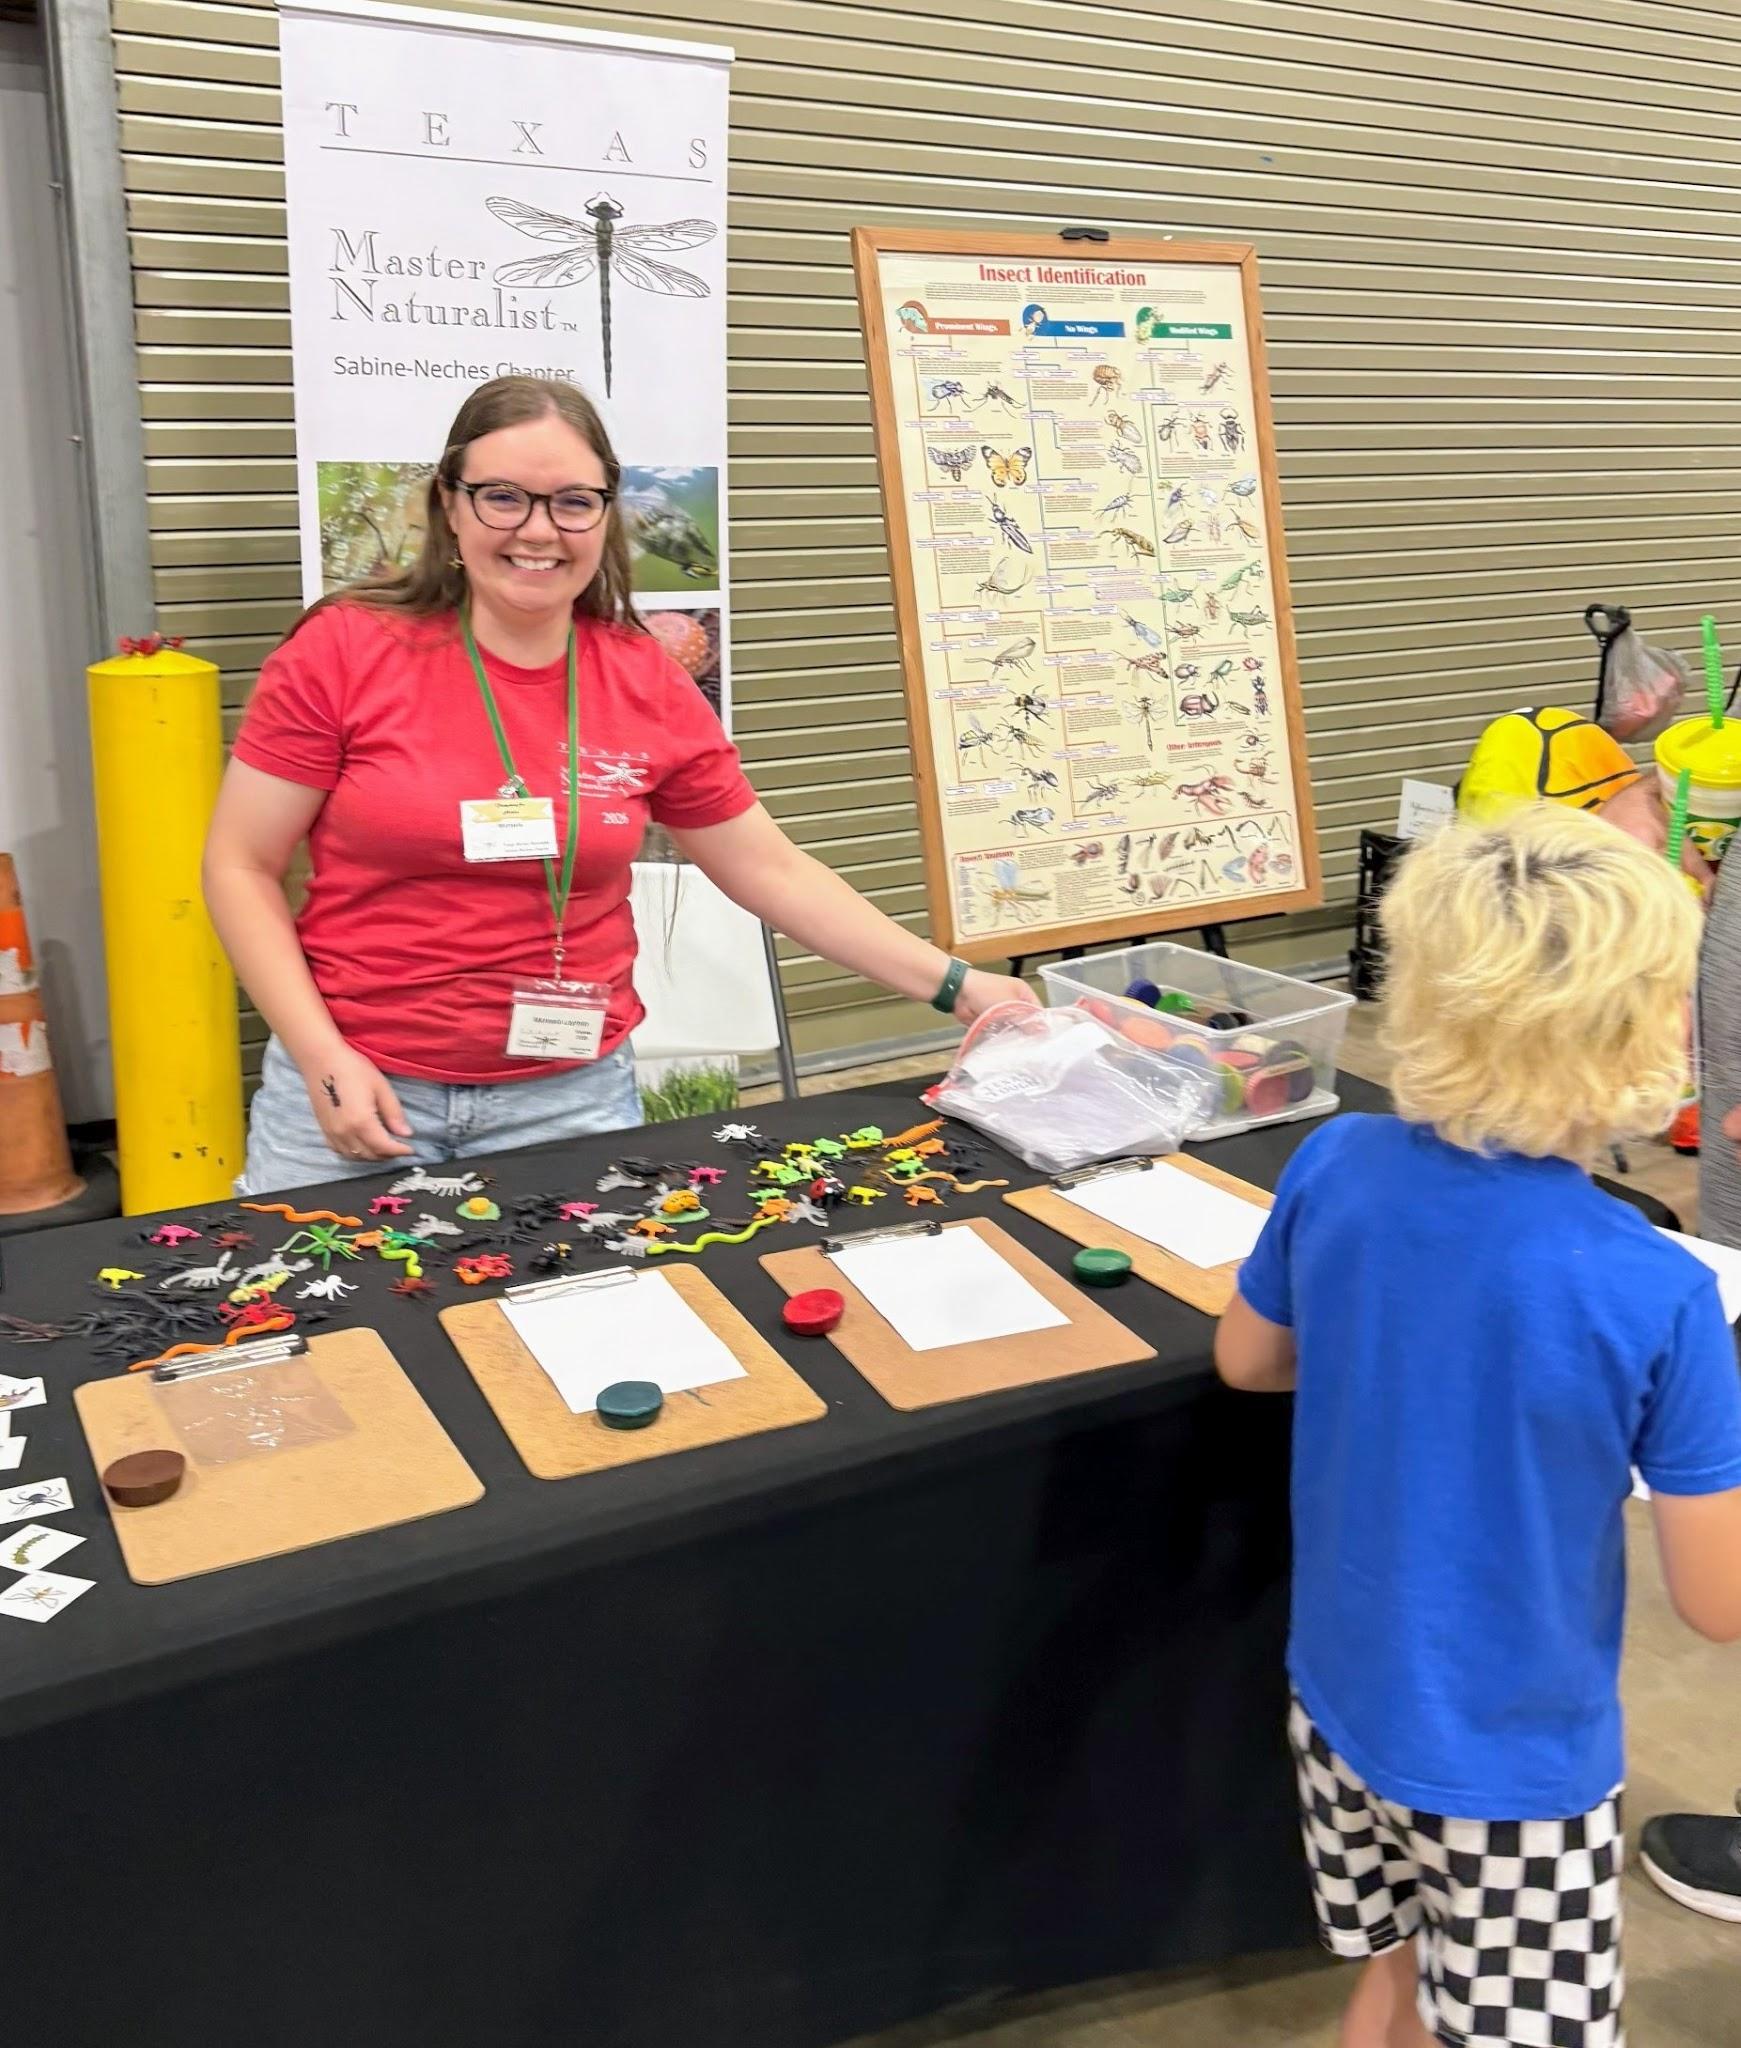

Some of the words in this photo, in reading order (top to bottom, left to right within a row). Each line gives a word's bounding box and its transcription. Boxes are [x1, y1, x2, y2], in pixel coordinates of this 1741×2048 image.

[329, 228, 486, 280] Master
[979, 264, 1031, 282] Insect
[1037, 267, 1147, 286] Identification
[333, 356, 490, 380] Sabine-Neches
